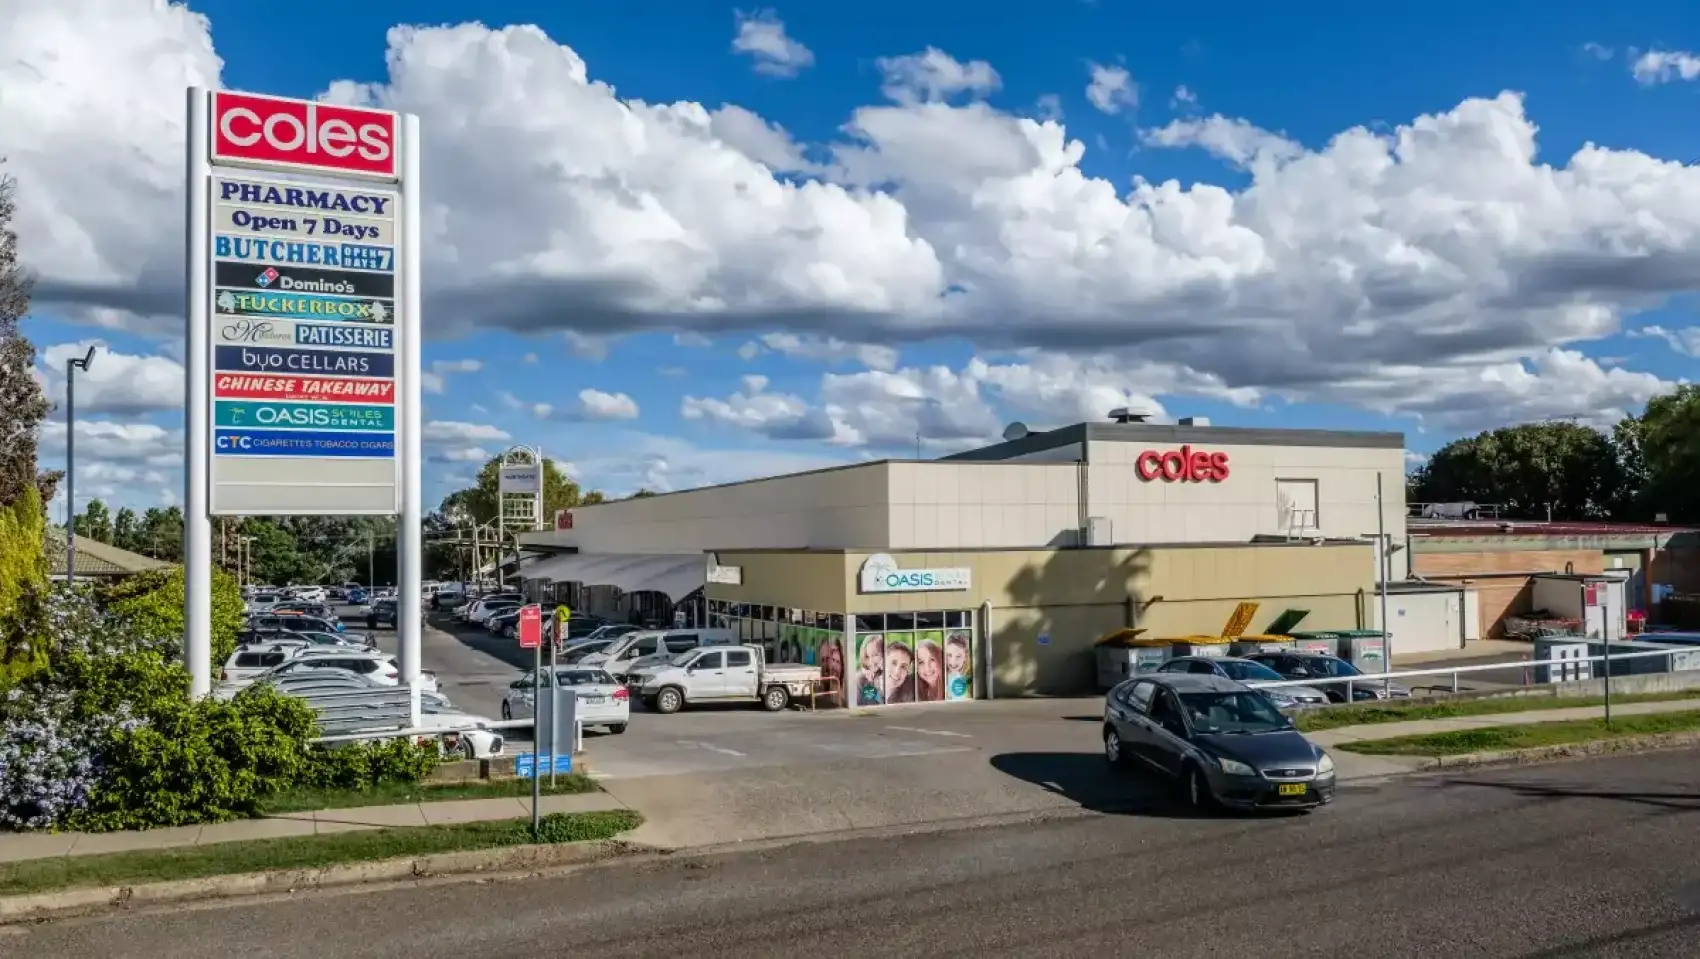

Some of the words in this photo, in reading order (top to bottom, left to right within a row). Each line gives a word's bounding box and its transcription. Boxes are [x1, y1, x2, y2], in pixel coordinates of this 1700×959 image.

[220, 104, 390, 161] coles
[220, 182, 390, 215] PHARMACY
[231, 210, 297, 232] Open
[302, 219, 317, 235] 7
[322, 217, 380, 239] Days
[216, 235, 341, 266] BUTCHER
[344, 247, 376, 258] OPEN
[377, 250, 392, 270] 7
[279, 275, 355, 294] Domino's
[235, 294, 371, 318] TUCKERBOX
[299, 325, 390, 347] PATISSERIE
[242, 348, 283, 371] byo
[287, 354, 370, 372] CELLARS
[217, 376, 297, 393] CHINESE
[301, 380, 392, 397] TAKEAWAY
[255, 407, 330, 426] OASIS
[331, 419, 384, 427] DENTAL
[216, 436, 252, 450] CTC
[253, 438, 314, 448] CIGARETTES
[315, 440, 358, 449] TOBACCO
[1137, 445, 1230, 482] coles
[886, 573, 933, 587] OASIS
